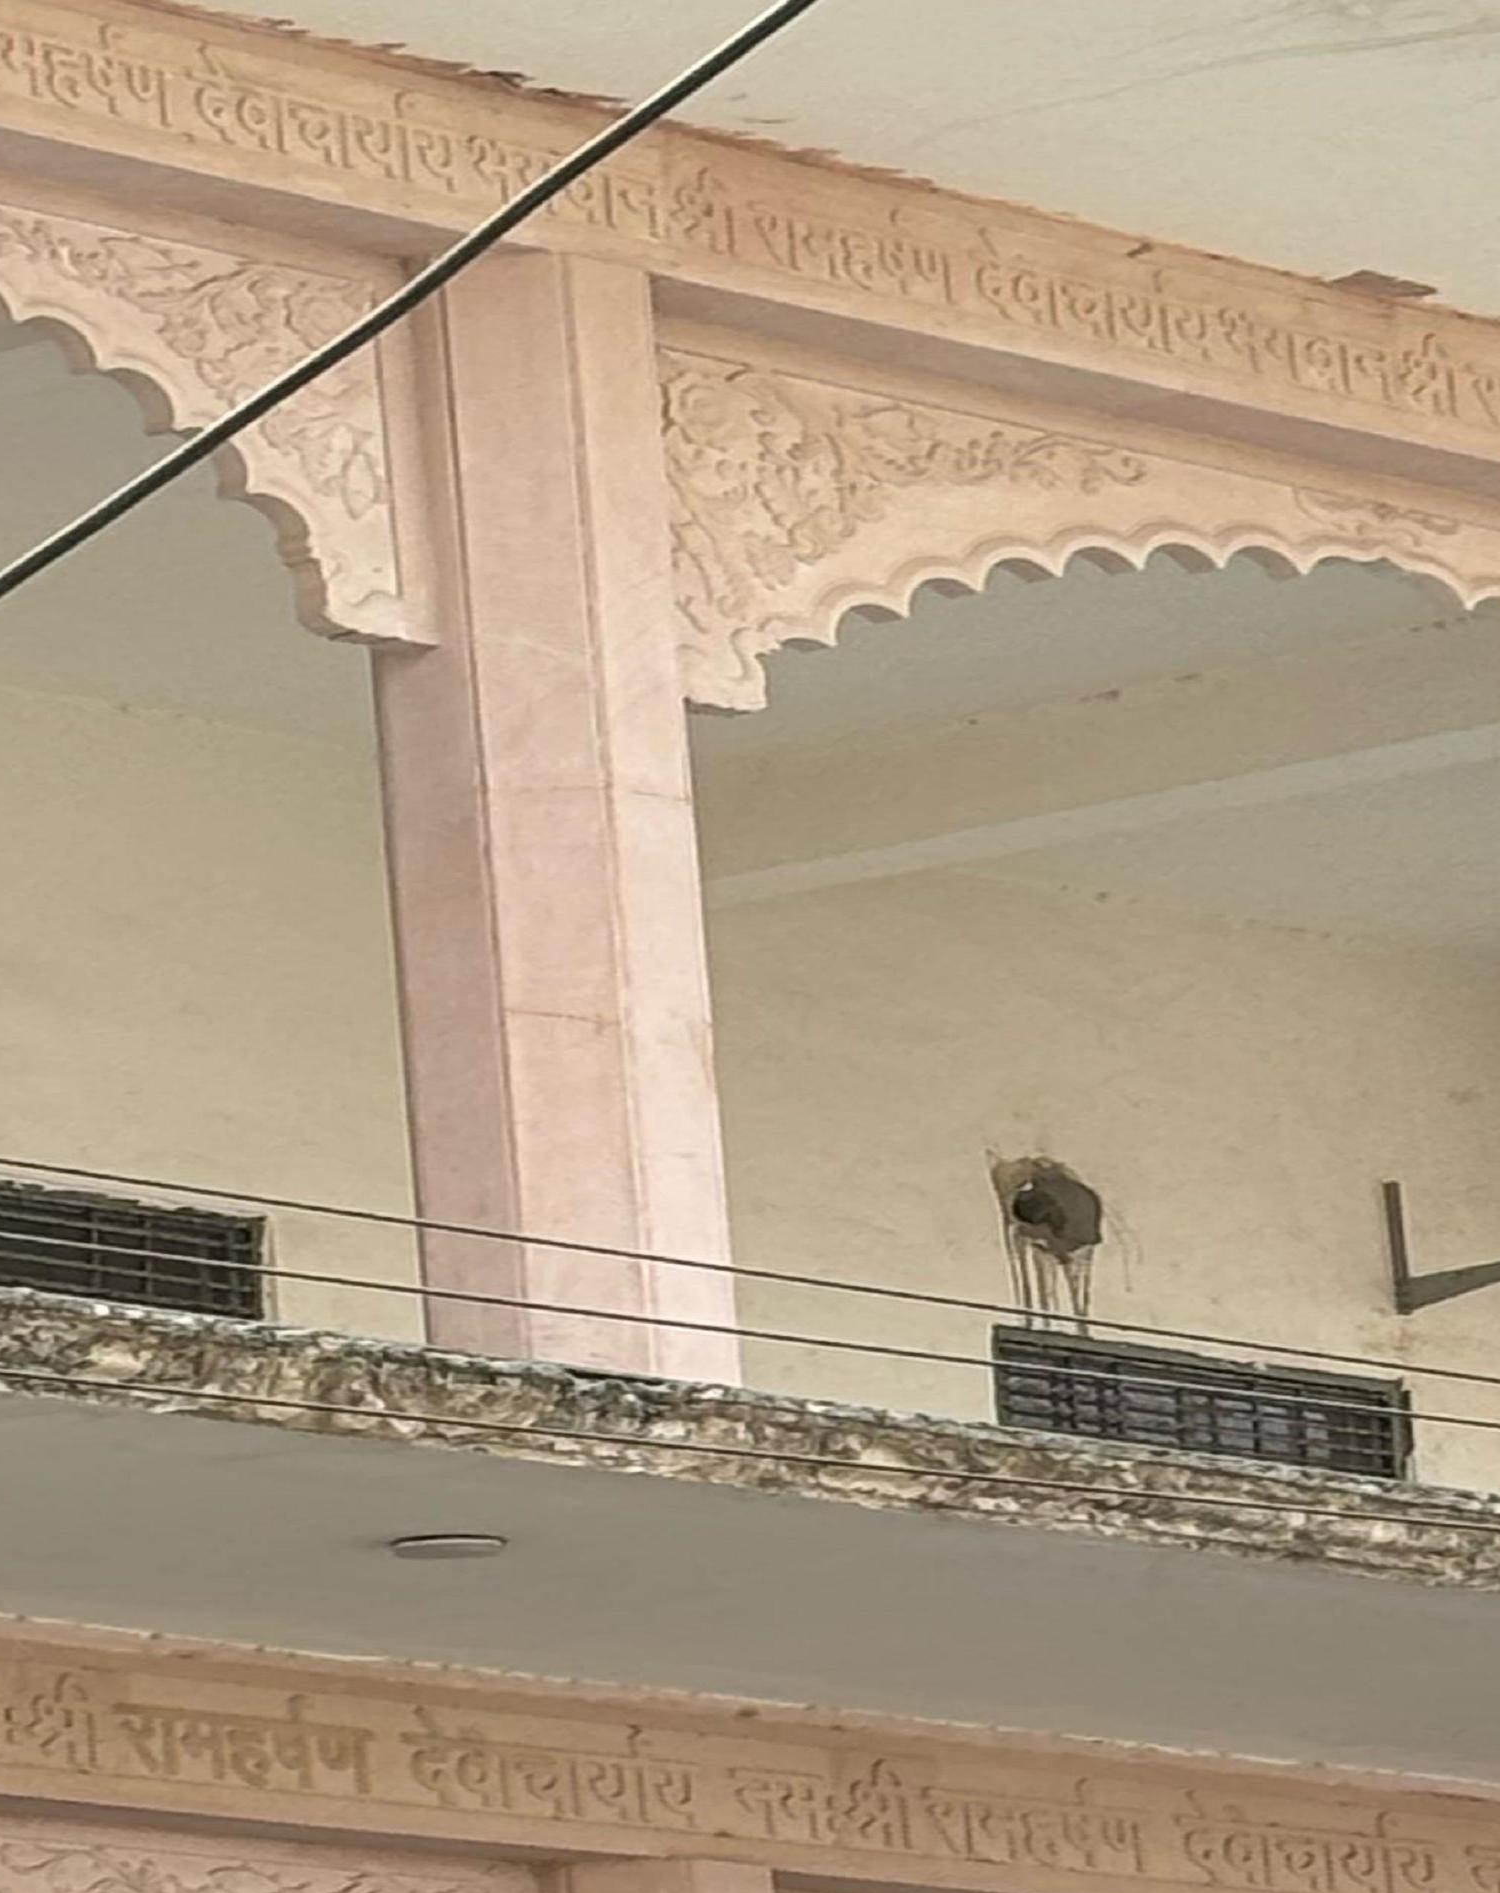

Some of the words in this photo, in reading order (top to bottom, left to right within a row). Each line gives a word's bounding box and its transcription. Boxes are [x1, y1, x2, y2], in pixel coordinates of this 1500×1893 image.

[666, 166, 736, 256] श्री
[750, 203, 952, 302] रामहर्षण
[1398, 331, 1460, 418] श्री
[20, 1670, 104, 1774] श्री
[112, 1691, 377, 1796] रामहर्षण
[840, 1758, 914, 1850] श्री
[920, 1775, 1150, 1880] रामहर्षण
